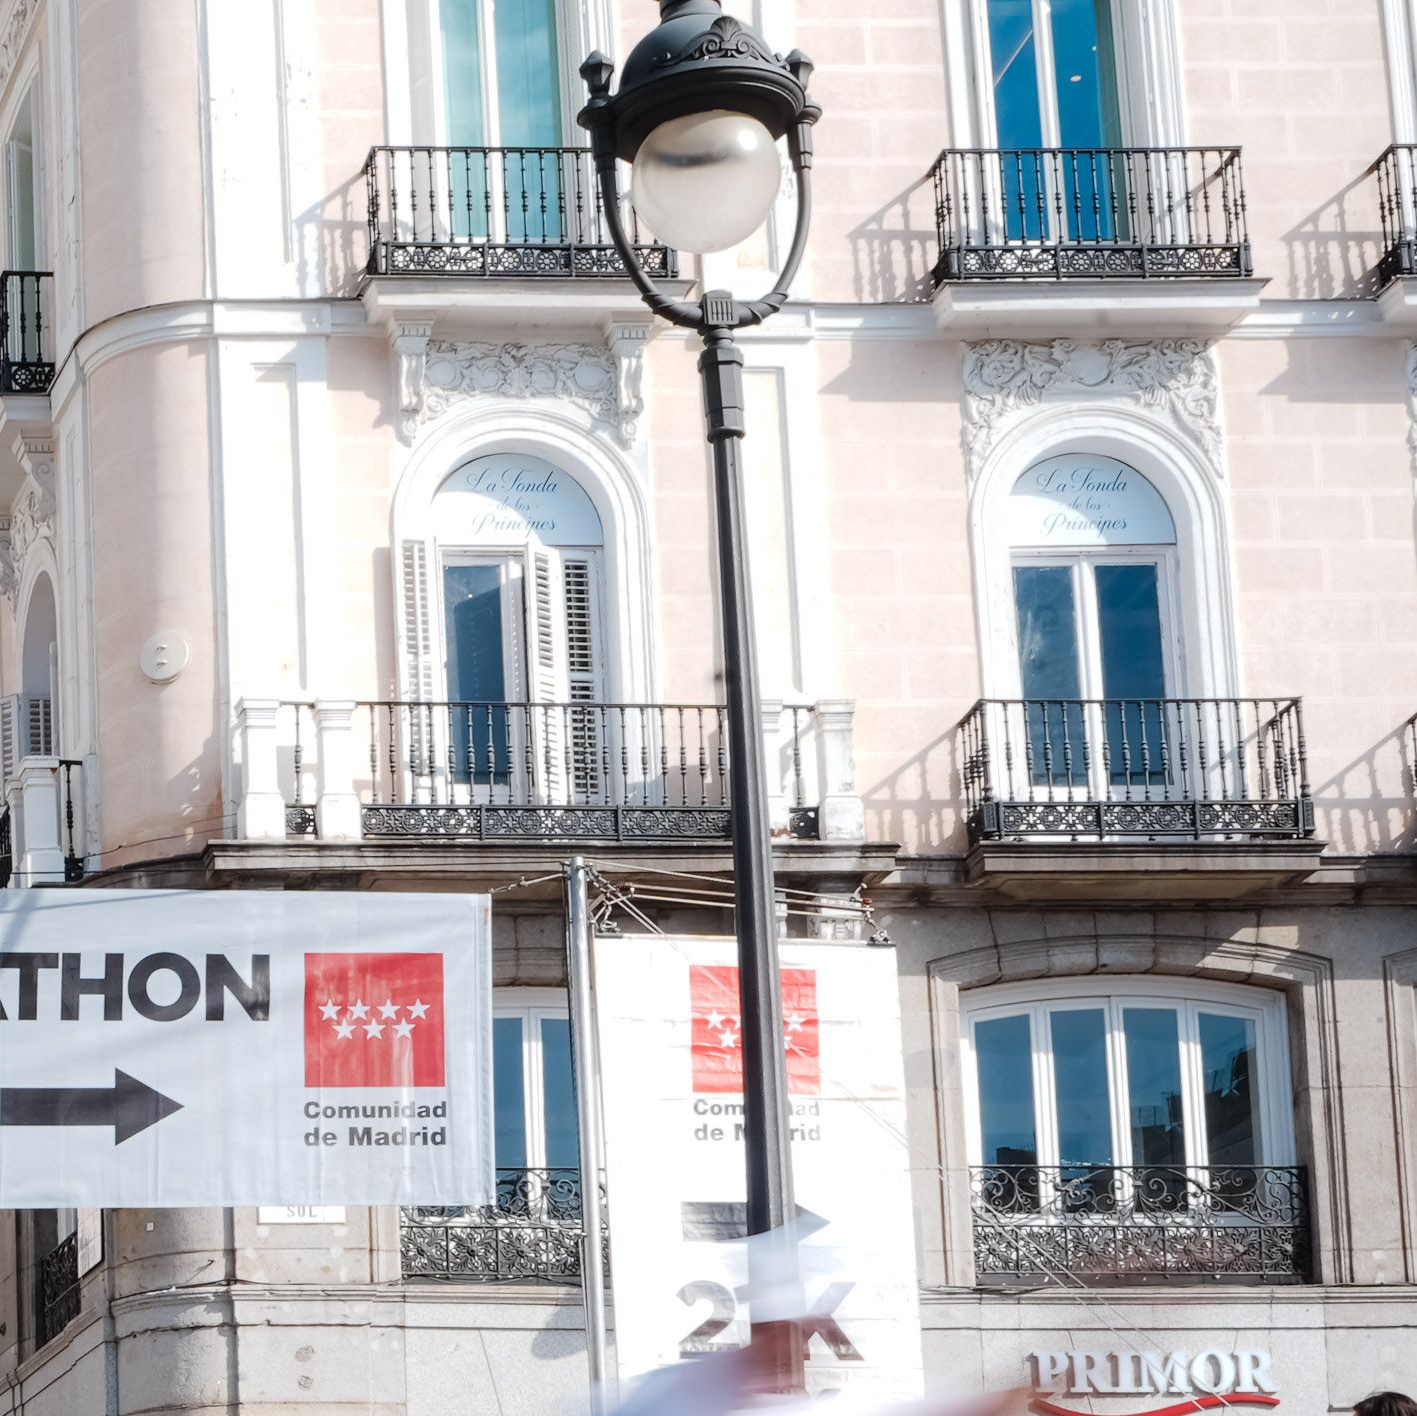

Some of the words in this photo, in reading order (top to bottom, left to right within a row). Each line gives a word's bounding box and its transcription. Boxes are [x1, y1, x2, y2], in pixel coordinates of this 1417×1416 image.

[466, 467, 497, 493] La
[500, 466, 558, 493] Fonda
[1036, 467, 1068, 494] La
[1070, 466, 1127, 493] Fonda
[514, 497, 530, 511] los
[1085, 497, 1101, 511] los
[303, 1100, 447, 1121] Comunidad
[693, 1099, 820, 1116] Comad
[304, 1126, 338, 1147] de
[347, 1126, 447, 1149] Madrid
[694, 1123, 724, 1141] de
[734, 1123, 821, 1141] Mrid
[676, 1280, 866, 1361] 2K
[1027, 1349, 1279, 1397] PRIMOR
